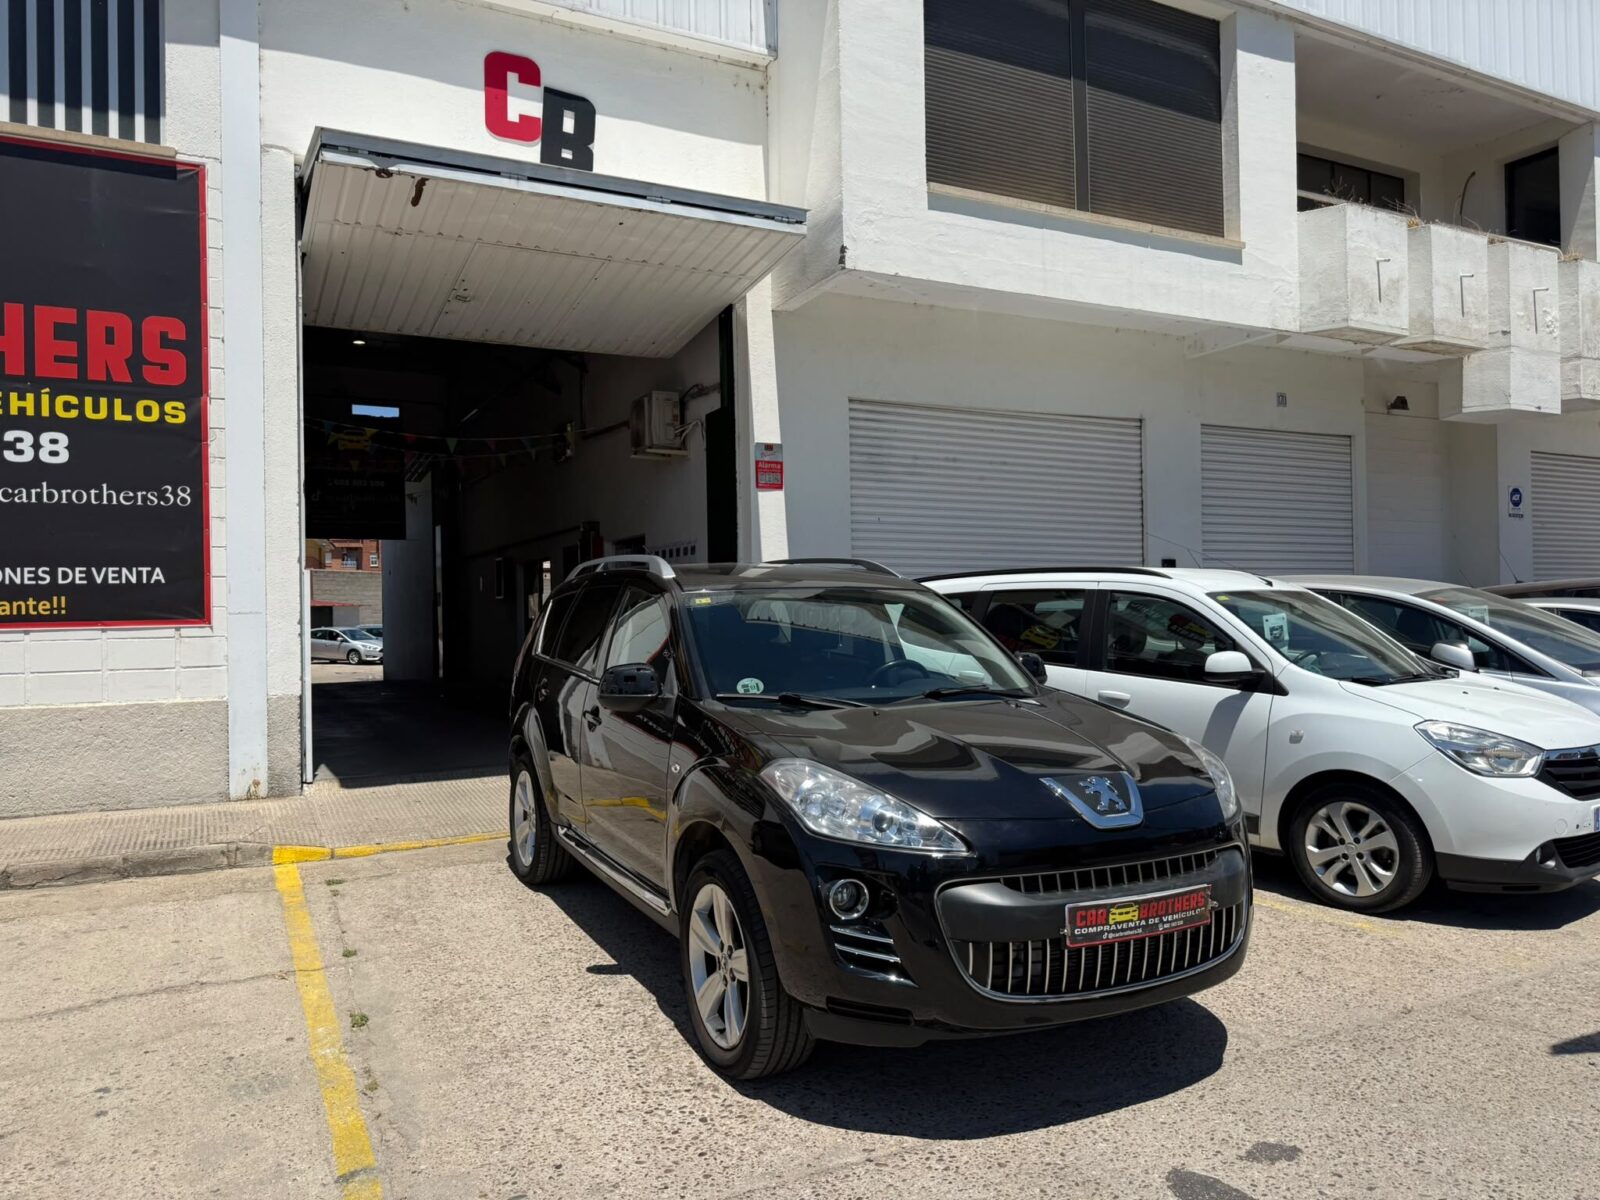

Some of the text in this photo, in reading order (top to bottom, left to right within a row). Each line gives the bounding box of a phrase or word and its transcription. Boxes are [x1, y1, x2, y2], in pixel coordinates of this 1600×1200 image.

[484, 51, 596, 172] CB
[0, 387, 187, 424] HÍCULOS
[3, 430, 70, 464] 38
[0, 481, 192, 507] carbrothers38
[0, 566, 166, 585] NES DE VENTA
[0, 596, 67, 615] ante!!
[1076, 892, 1205, 927] CAR BROTHERS
[1074, 920, 1146, 935] COMPRAVENTA
[1148, 917, 1160, 925] DE
